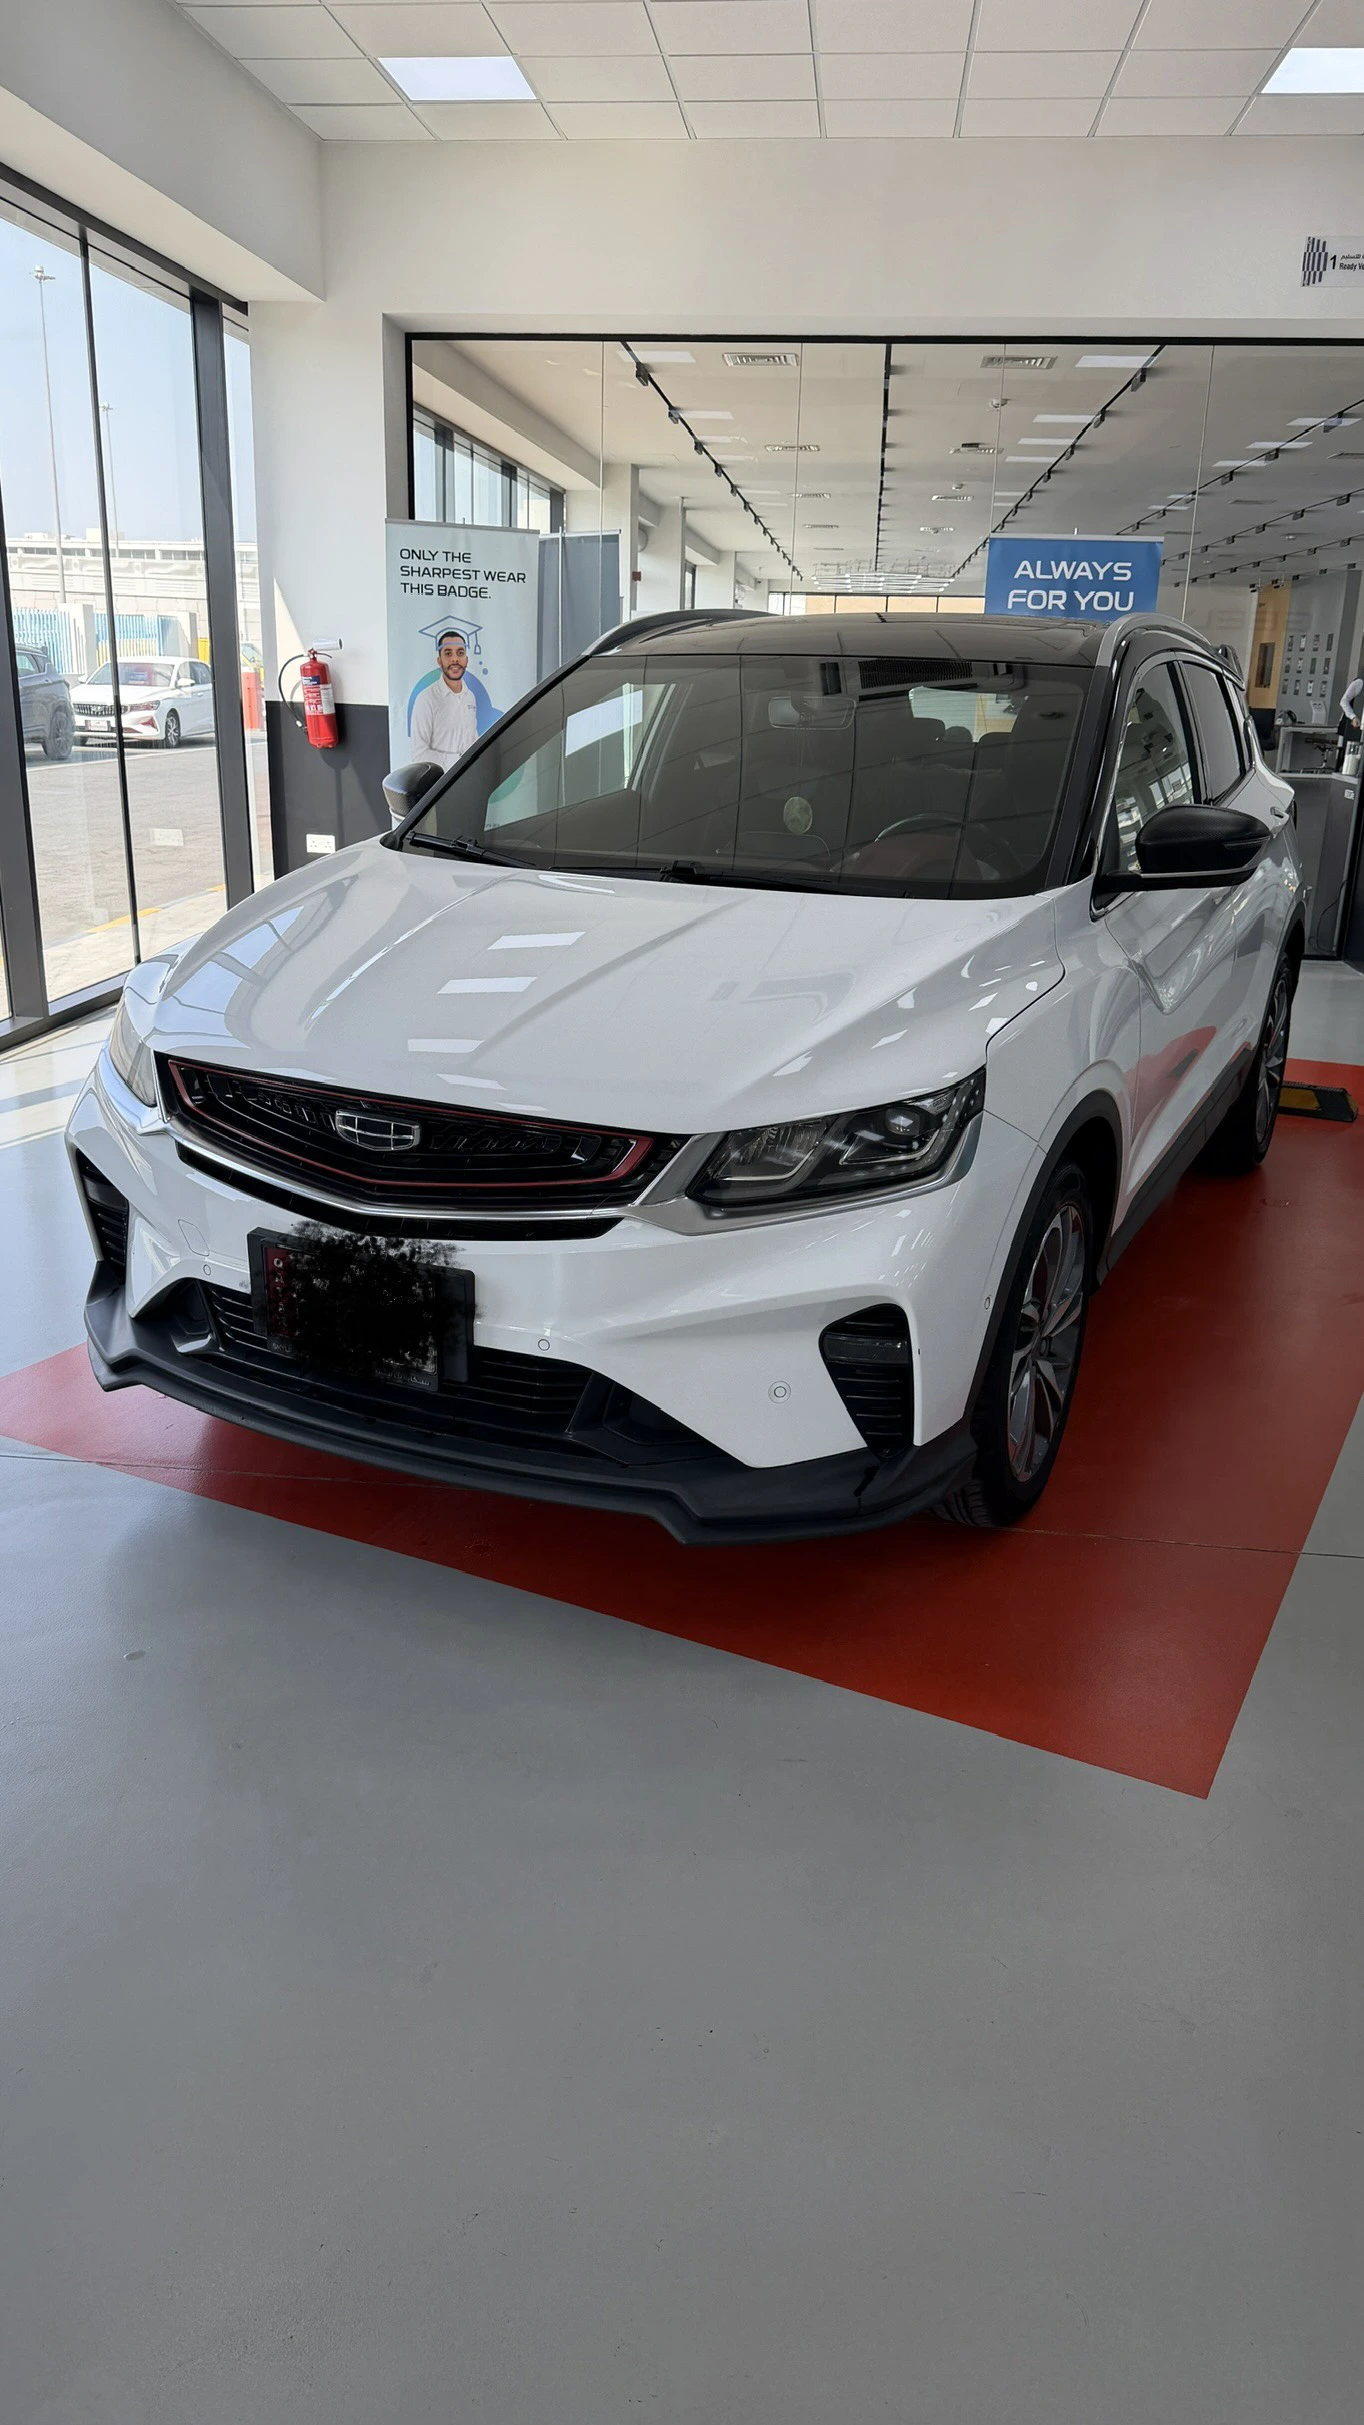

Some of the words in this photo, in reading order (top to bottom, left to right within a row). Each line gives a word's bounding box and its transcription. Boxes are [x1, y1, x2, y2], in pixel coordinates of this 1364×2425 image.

[1330, 254, 1337, 270] 1
[1339, 262, 1357, 272] Ready
[399, 548, 439, 561] ONLY
[442, 551, 472, 563] THE
[400, 565, 481, 580] SHARPEST
[483, 570, 526, 583] WEAR
[1013, 560, 1132, 581] ALWAYS
[400, 582, 434, 596] THIS
[437, 584, 491, 599] BADGE.
[1007, 589, 1067, 610] FOR
[1074, 590, 1134, 611] YOU
